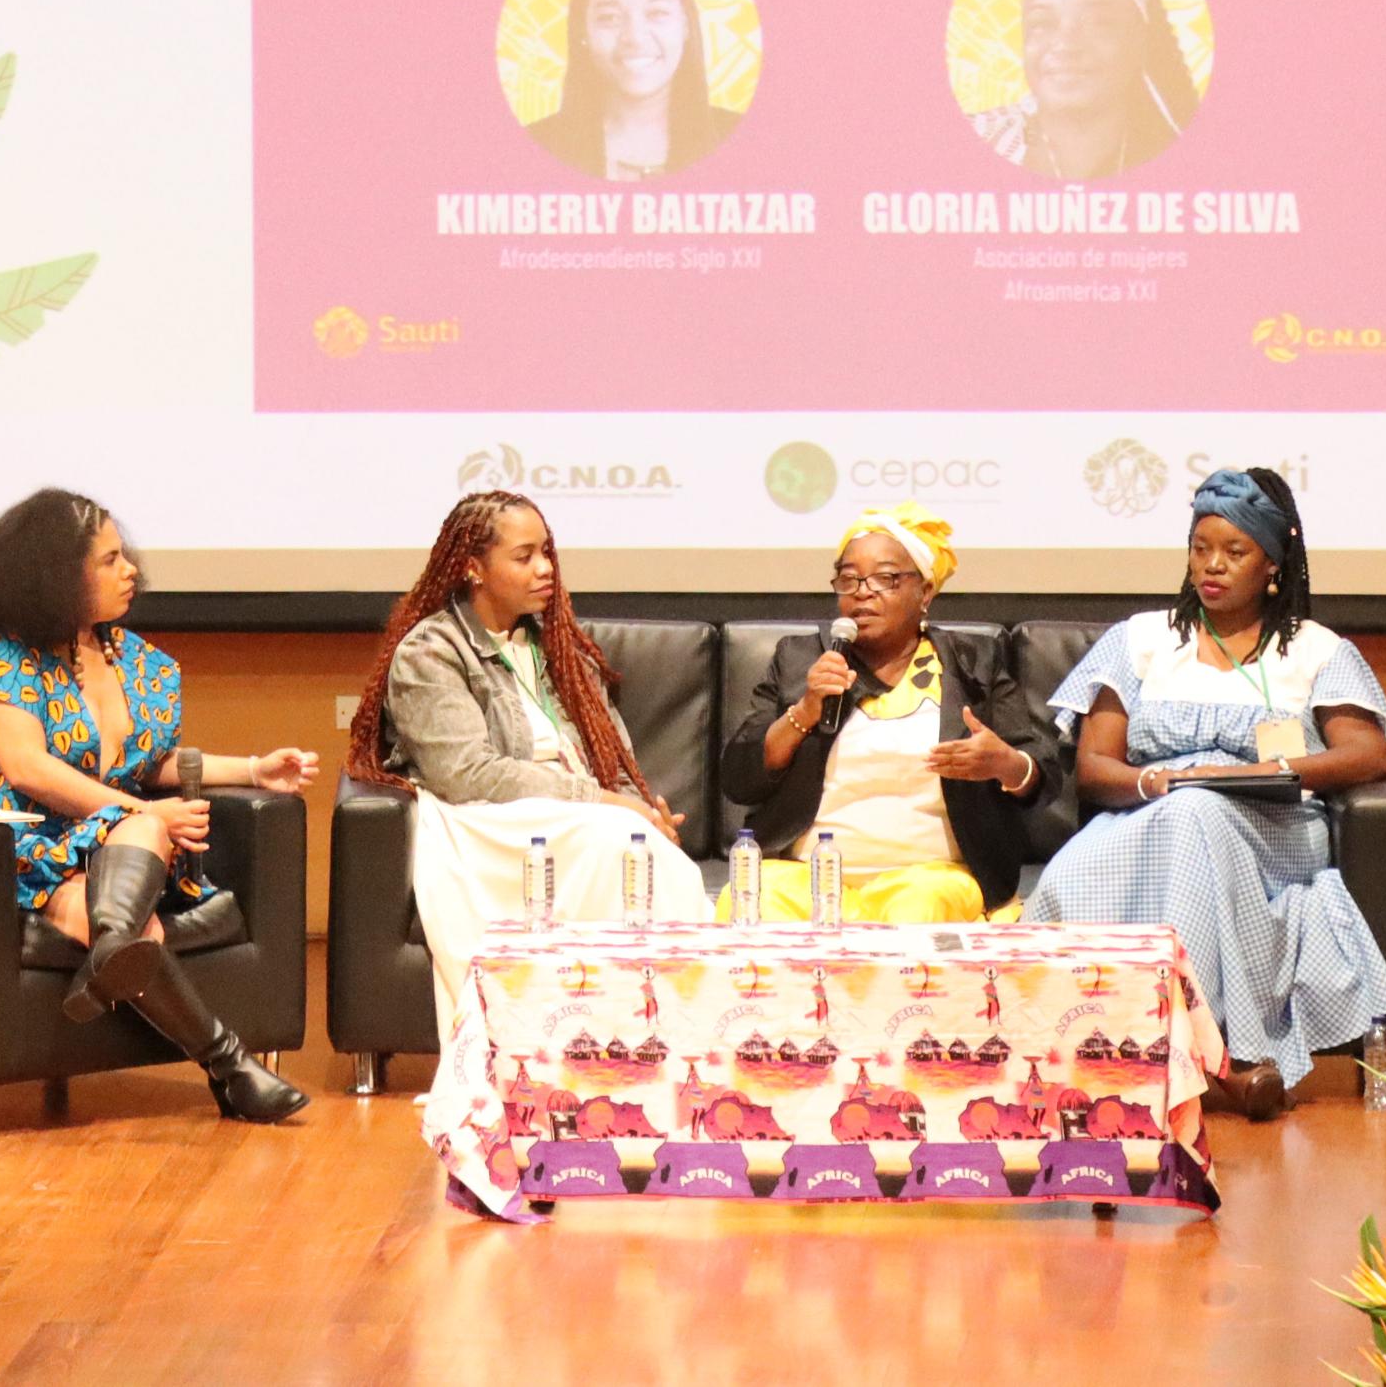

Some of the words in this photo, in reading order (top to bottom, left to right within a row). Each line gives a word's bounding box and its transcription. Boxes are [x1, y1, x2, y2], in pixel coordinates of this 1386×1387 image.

[436, 194, 622, 234] KIMBERLY
[632, 193, 814, 233] BALTAZAR
[863, 192, 999, 234] GLORIA
[1008, 185, 1127, 233] NUÑEZ
[1138, 193, 1184, 233] DE
[1193, 192, 1300, 233] SILVA
[499, 246, 675, 269] Afrodescendientes
[680, 246, 725, 273] Siglo
[731, 247, 760, 269] XXI
[1081, 247, 1106, 269] de
[1111, 247, 1188, 272] mujeres
[1127, 279, 1157, 302] XXI
[379, 315, 460, 342] Sauti
[530, 464, 683, 490] C.N.O.A.
[850, 460, 1001, 495] cepac
[885, 1004, 934, 1038] AFRICA
[1055, 1003, 1105, 1038] AFRICA
[551, 1167, 607, 1187] AFRICA
[679, 1167, 734, 1189] AFRICA
[807, 1168, 862, 1189] AFRICA
[935, 1167, 990, 1188] AFRICA
[1061, 1166, 1115, 1187] AFRICA
